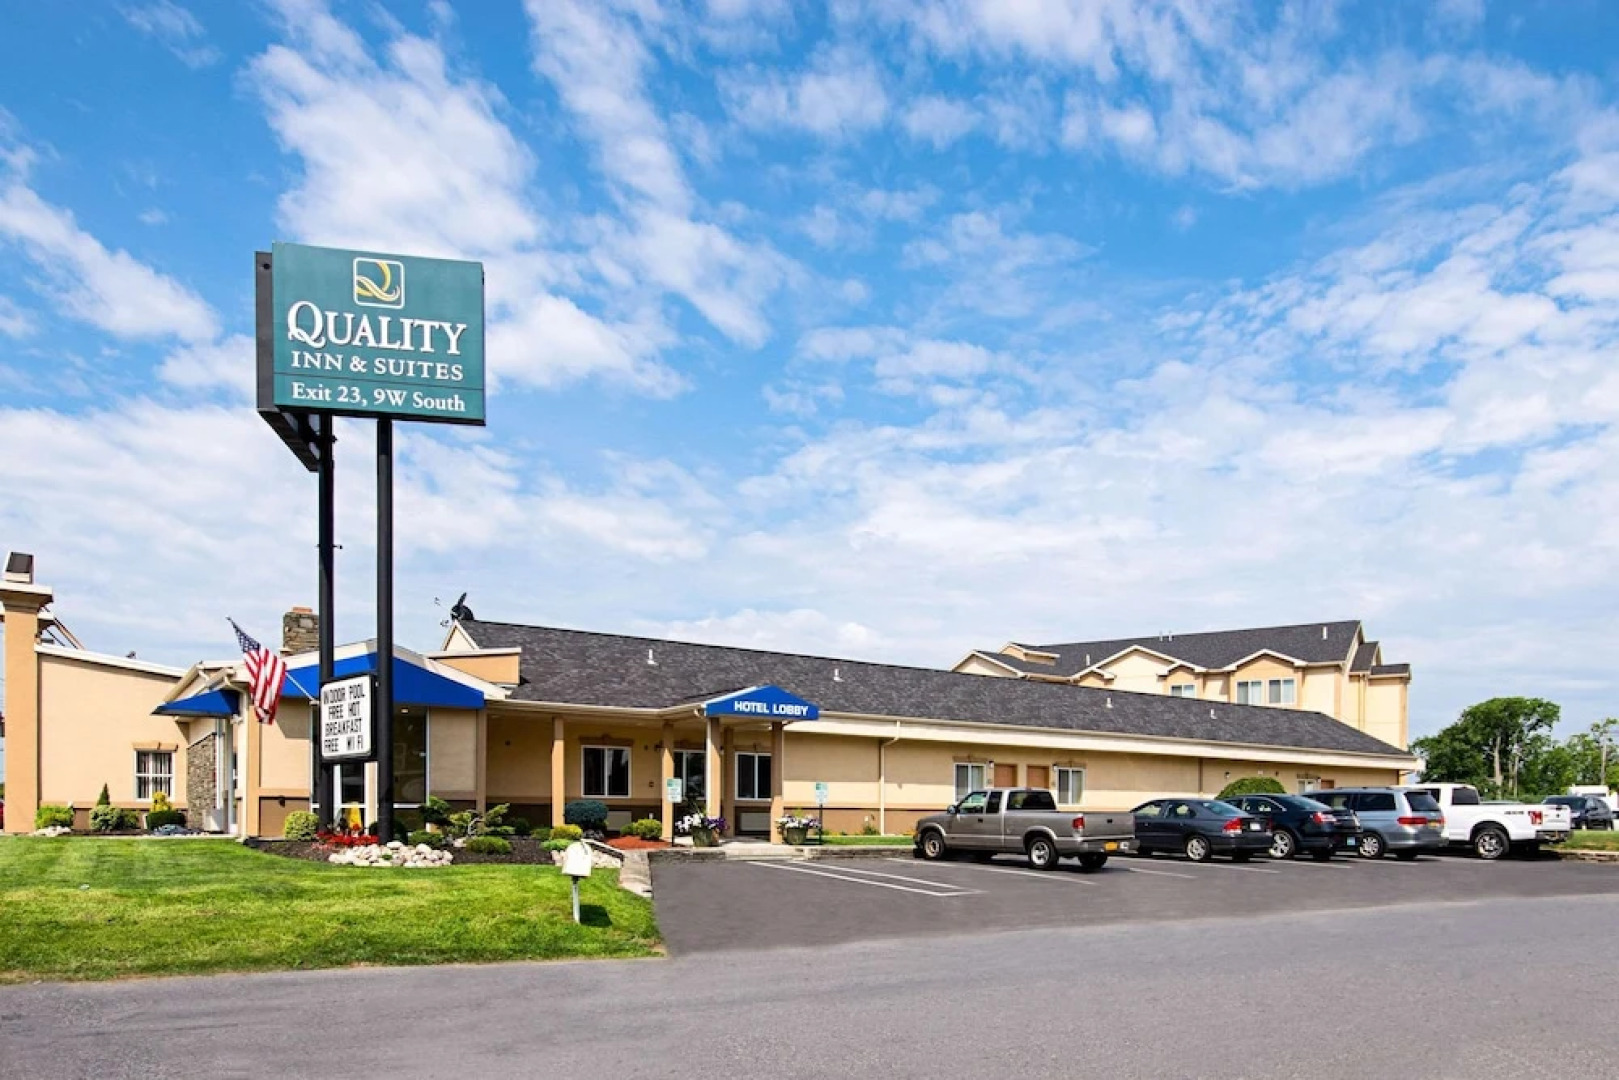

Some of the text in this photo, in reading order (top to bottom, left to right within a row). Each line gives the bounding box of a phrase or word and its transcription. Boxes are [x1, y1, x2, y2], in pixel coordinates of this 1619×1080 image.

[287, 300, 467, 355] QUALITY
[291, 351, 463, 381] INN & SUITES
[292, 382, 466, 412] Exit 23, 9W South
[349, 683, 365, 700] POOL
[328, 700, 360, 720] FREE HOT
[734, 701, 809, 717] HOTEL LOBBY
[325, 717, 362, 737] BREAKFAST
[324, 738, 339, 753] FREE
